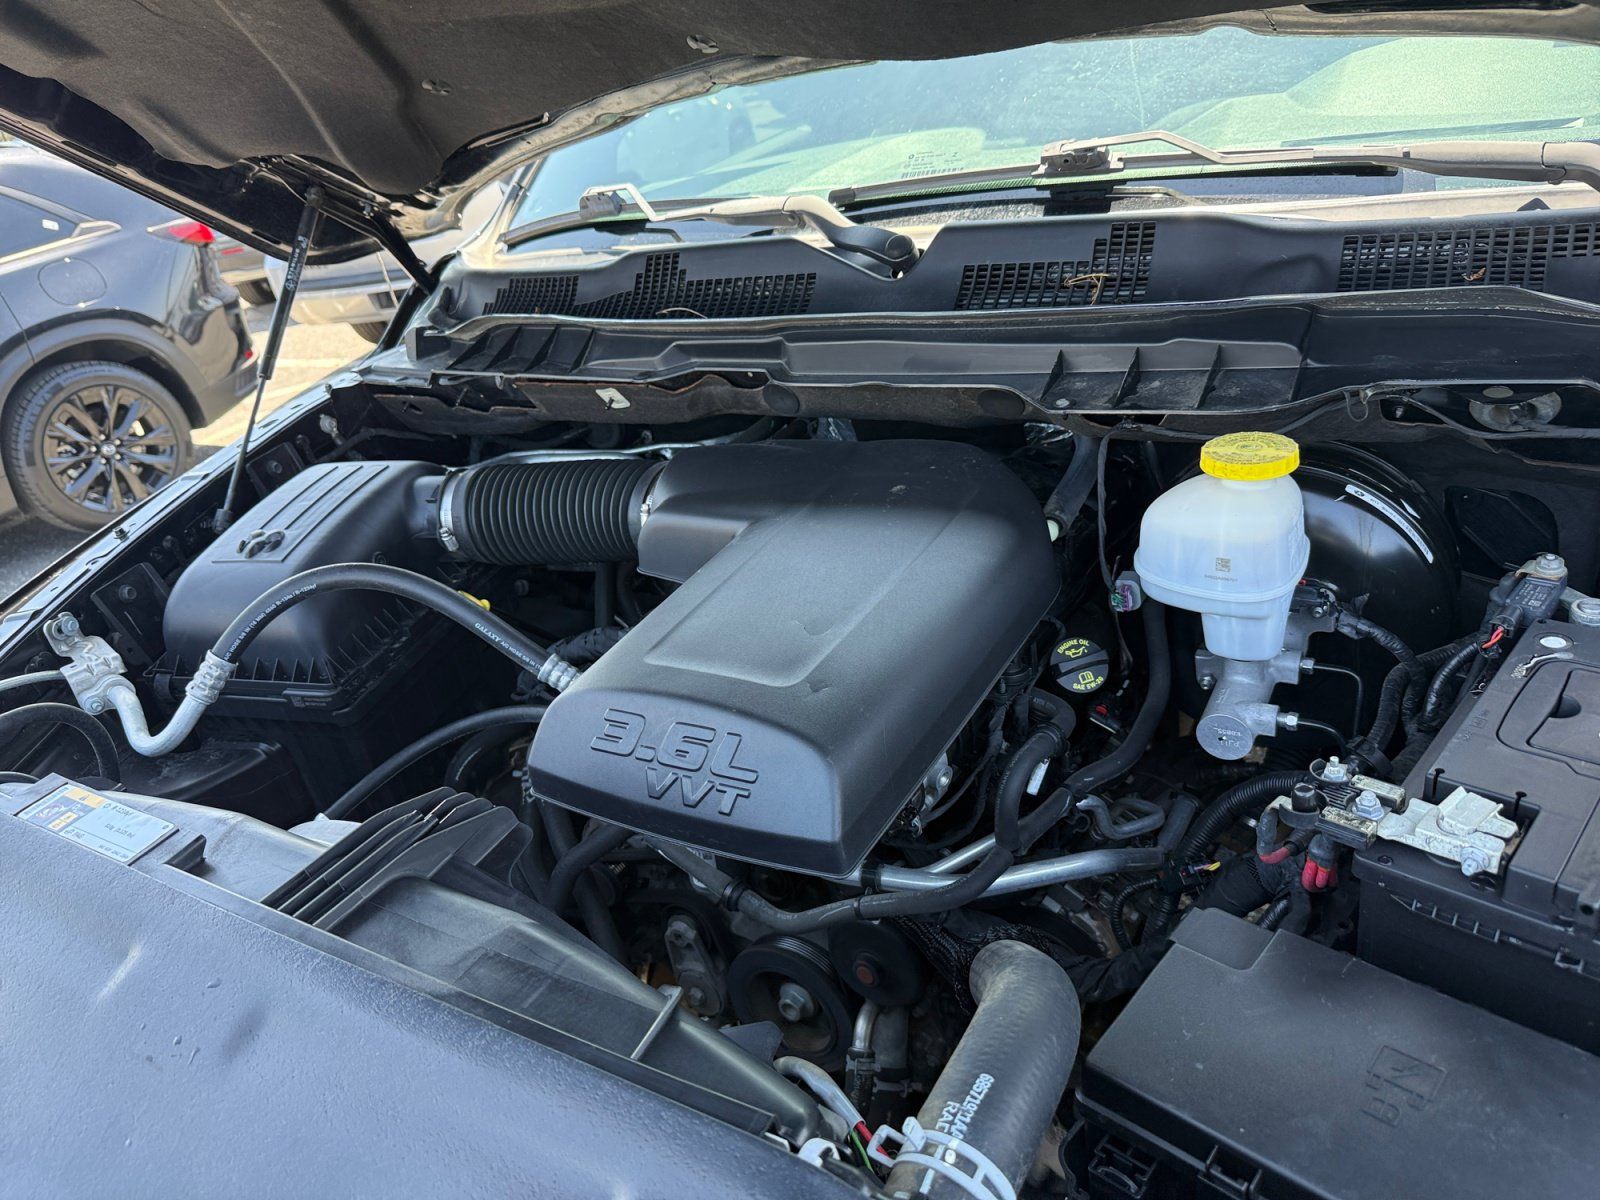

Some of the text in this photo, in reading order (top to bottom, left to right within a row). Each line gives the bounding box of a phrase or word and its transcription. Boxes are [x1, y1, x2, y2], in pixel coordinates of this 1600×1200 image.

[474, 622, 501, 642] GALAXY
[1057, 638, 1090, 654] ENGINE OIL
[1072, 676, 1104, 690] SAE 5W-20
[590, 708, 759, 784] 3.6L
[646, 766, 752, 816] VVT
